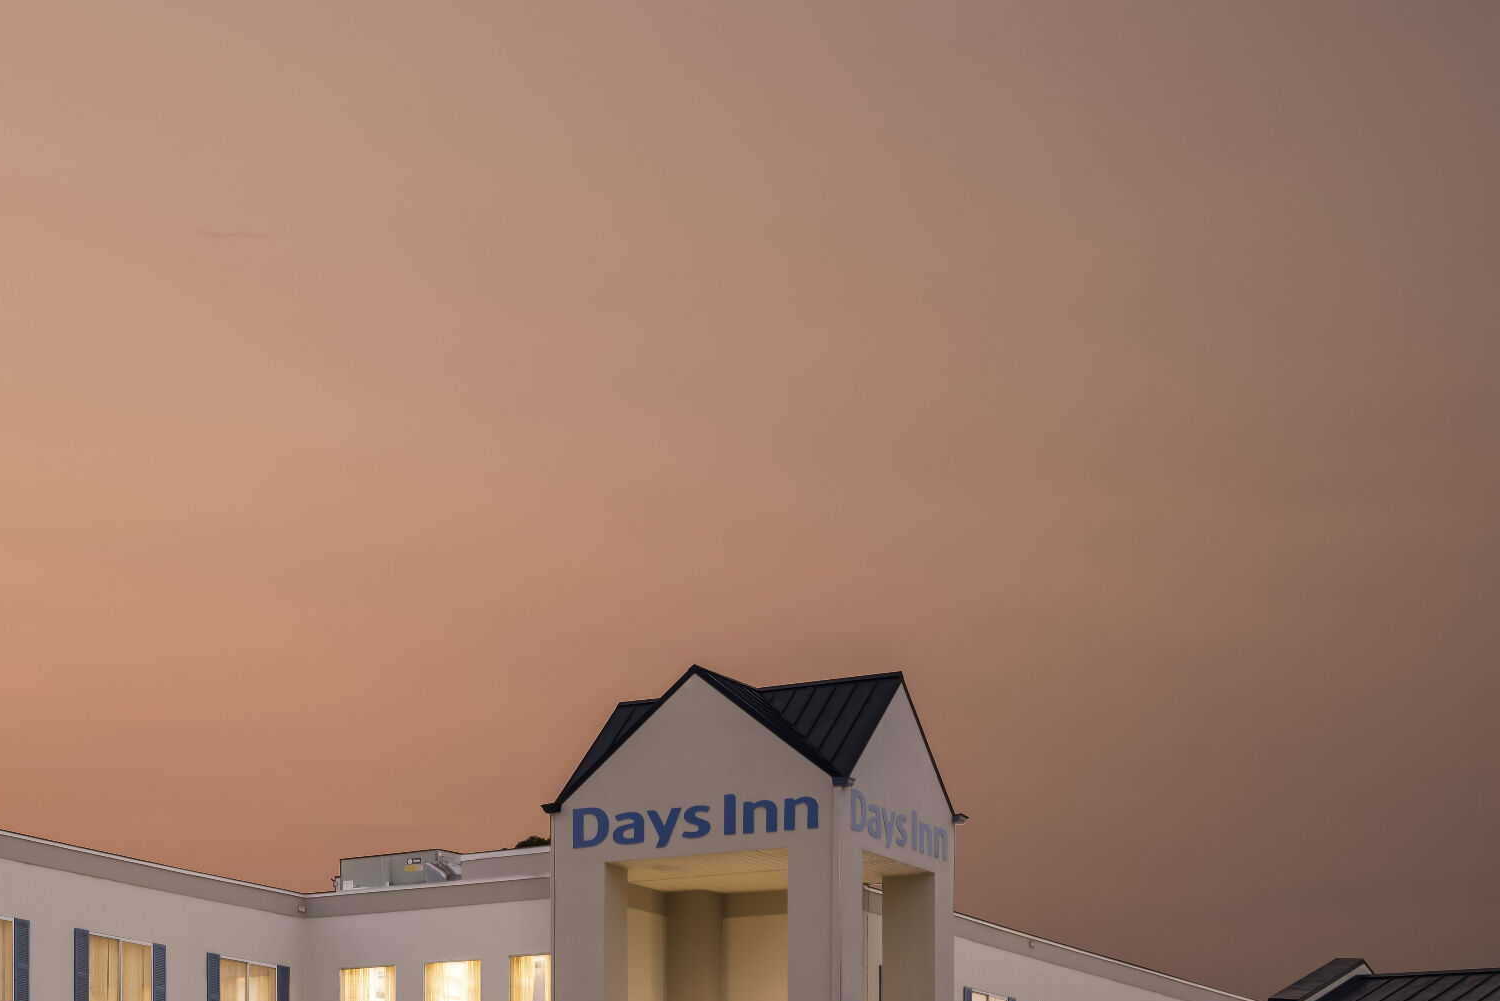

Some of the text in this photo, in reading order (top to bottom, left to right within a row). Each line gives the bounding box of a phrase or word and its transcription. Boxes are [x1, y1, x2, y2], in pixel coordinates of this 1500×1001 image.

[572, 794, 819, 849] Days Inn
[850, 787, 949, 861] Days Inn
